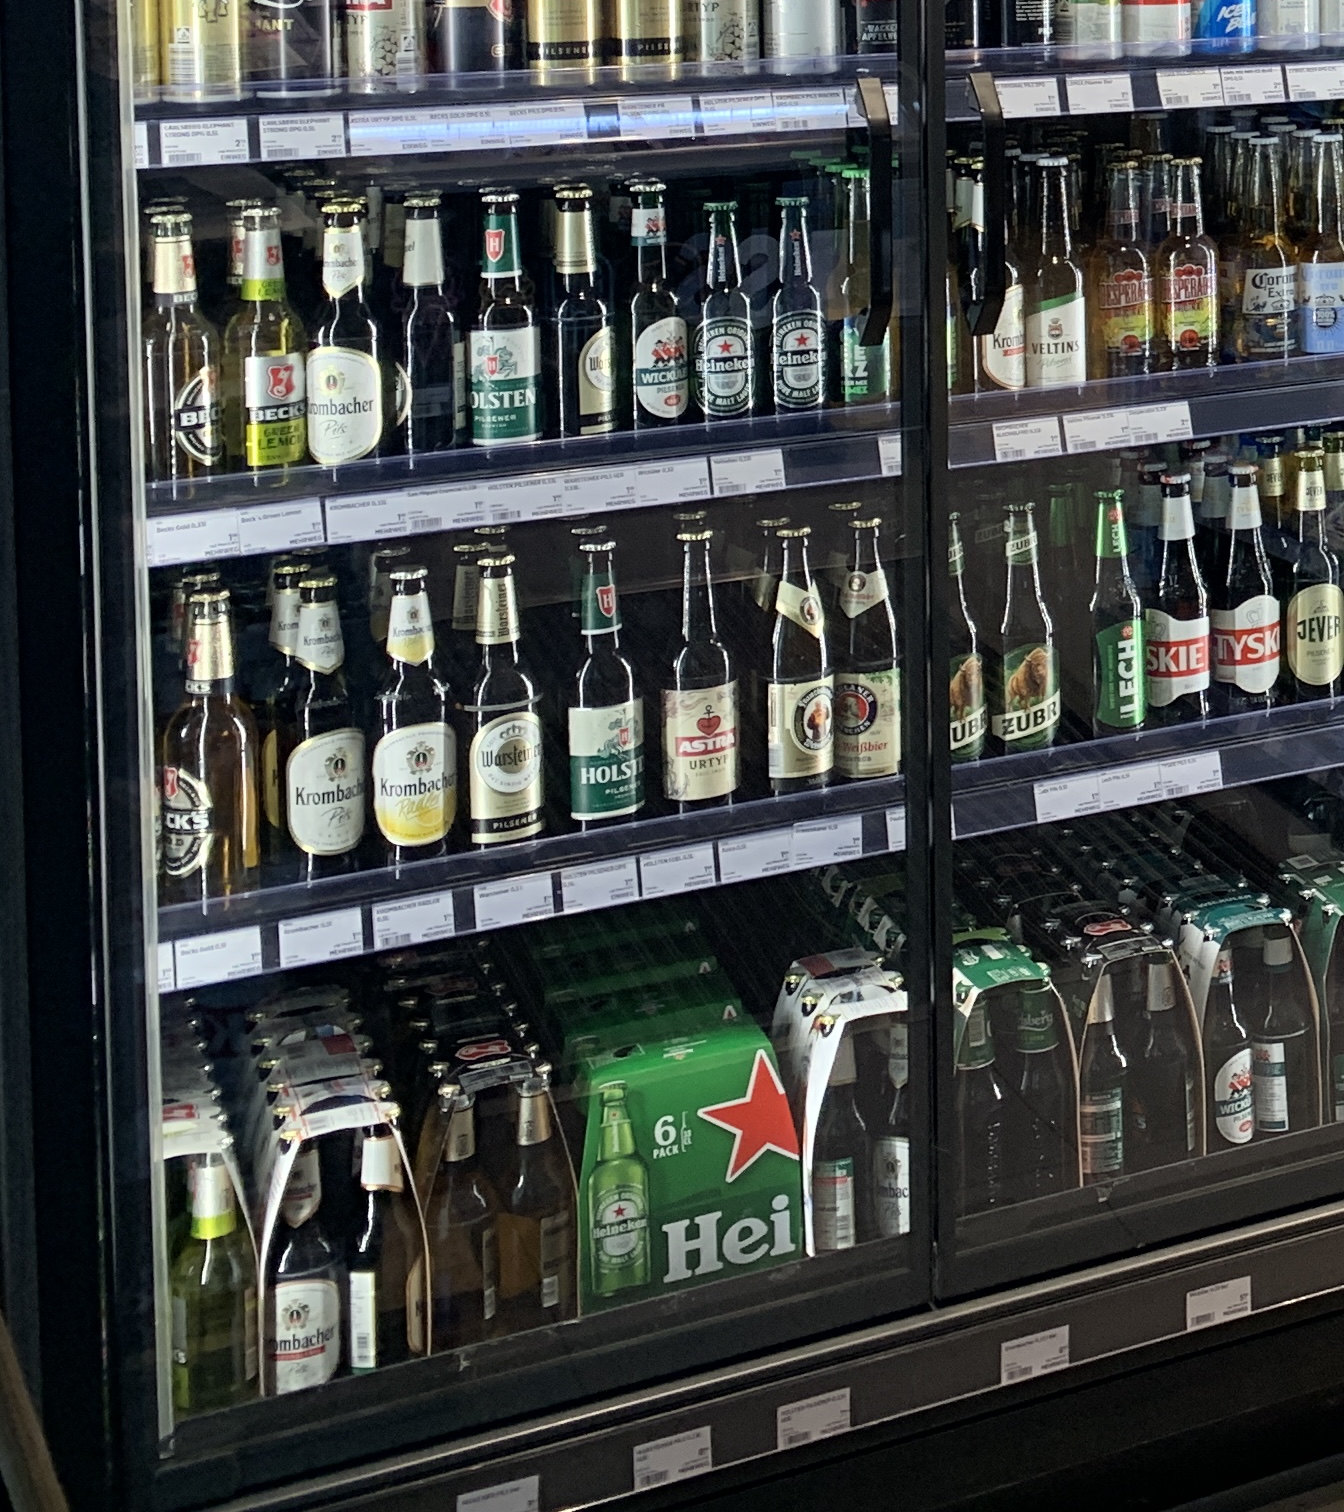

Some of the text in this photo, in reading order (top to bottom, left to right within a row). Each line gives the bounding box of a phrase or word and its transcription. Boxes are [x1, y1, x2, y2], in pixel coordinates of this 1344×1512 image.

[1031, 341, 1080, 356] VELTINS
[696, 357, 755, 372] Heineken
[1298, 615, 1341, 642] JEVER
[654, 1114, 677, 1145] 6
[653, 1143, 679, 1159] PACK
[593, 1217, 648, 1240] Heineken
[662, 1195, 796, 1283] Hei
